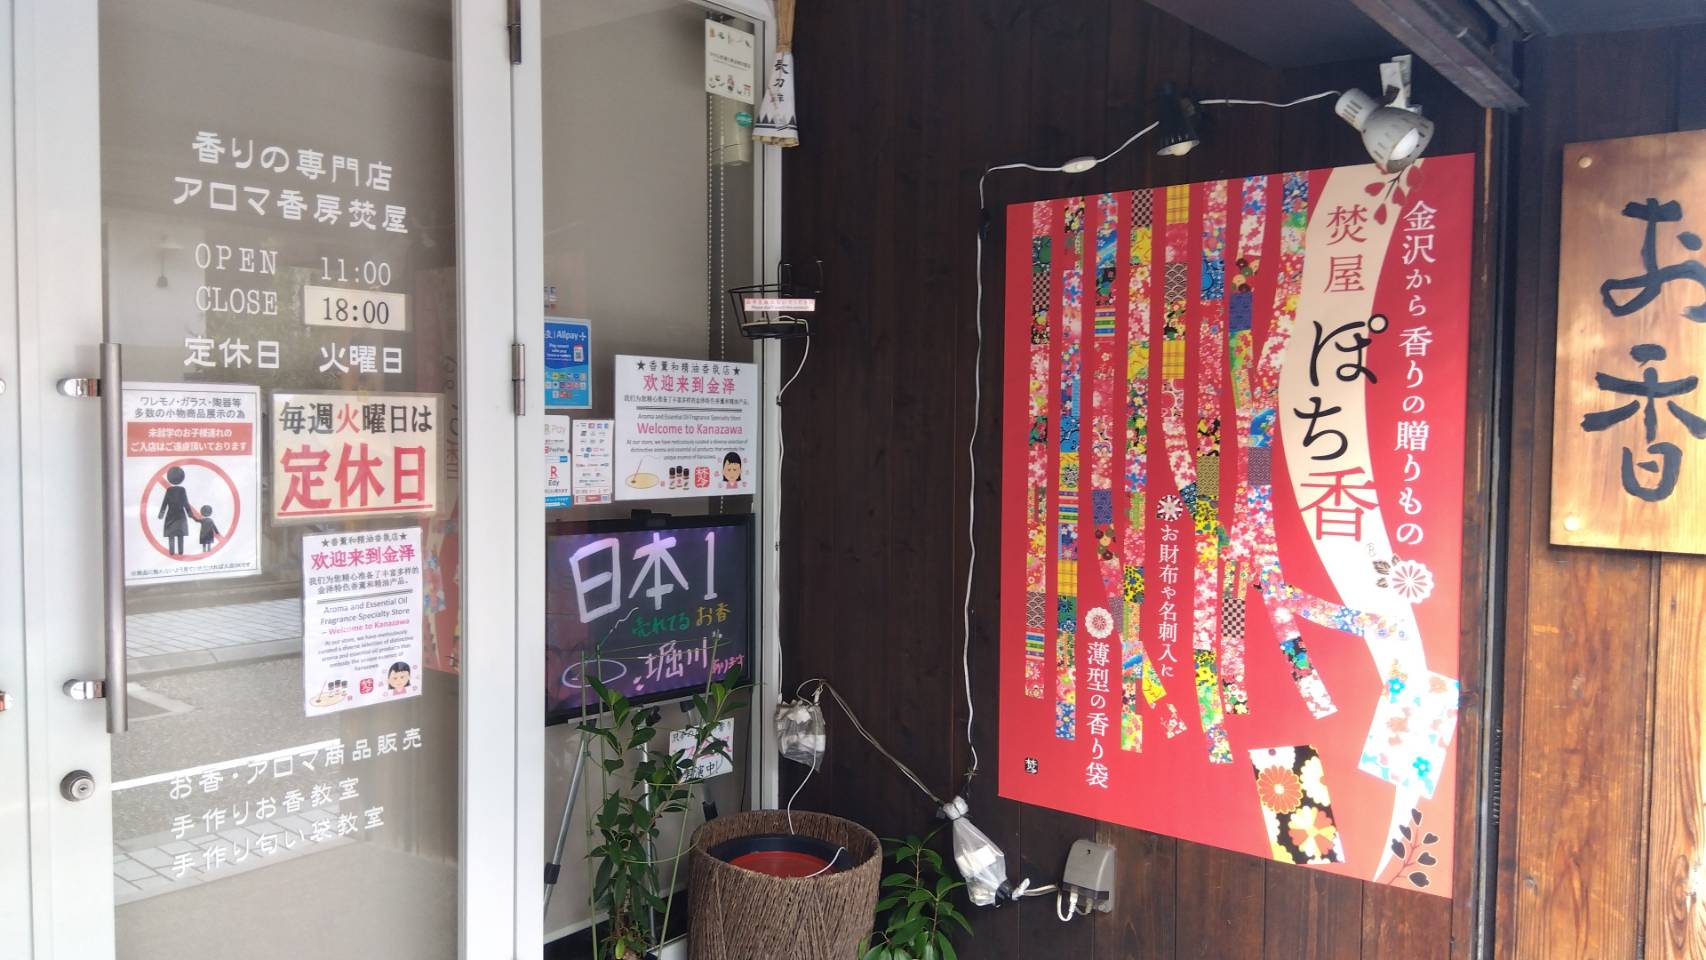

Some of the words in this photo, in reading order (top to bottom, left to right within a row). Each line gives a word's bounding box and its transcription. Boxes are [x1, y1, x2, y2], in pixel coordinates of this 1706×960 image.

[192, 131, 392, 191] 香りの専門店
[173, 176, 408, 234] アロマ香房焚屋
[195, 243, 278, 275] OPEN
[321, 257, 391, 286] 11:00
[1323, 203, 1369, 294] 焚屋
[195, 286, 278, 316] CLOSE
[322, 297, 390, 324] 18:00
[184, 337, 280, 369] 定休日
[319, 343, 402, 373] 火曜日
[1394, 200, 1438, 546] 金沢から香りの贈りもの
[1580, 197, 1706, 502] お香
[643, 373, 735, 395] 欢迎来到金泽
[279, 402, 432, 434] 毎週火曜日は
[637, 423, 682, 434] Welcome
[685, 424, 693, 434] to
[697, 424, 742, 434] Kanazawa
[1293, 312, 1390, 542] ぽち香
[280, 442, 426, 511] 定休日
[310, 544, 416, 570] 欢迎来到金泽
[320, 615, 356, 625] Fragrance
[358, 610, 389, 620] Specialty
[324, 605, 348, 614] Aroma
[350, 602, 364, 610] and
[366, 598, 396, 608] Essential
[398, 597, 408, 605] Oil
[1157, 525, 1179, 678] お財布や名刺入に
[1084, 641, 1110, 789] 薄型の香り袋
[169, 728, 422, 800] お香・アロマ商品販売
[171, 777, 359, 839] 手作りお香教室
[171, 806, 385, 878] 手作り匂い袋教室
